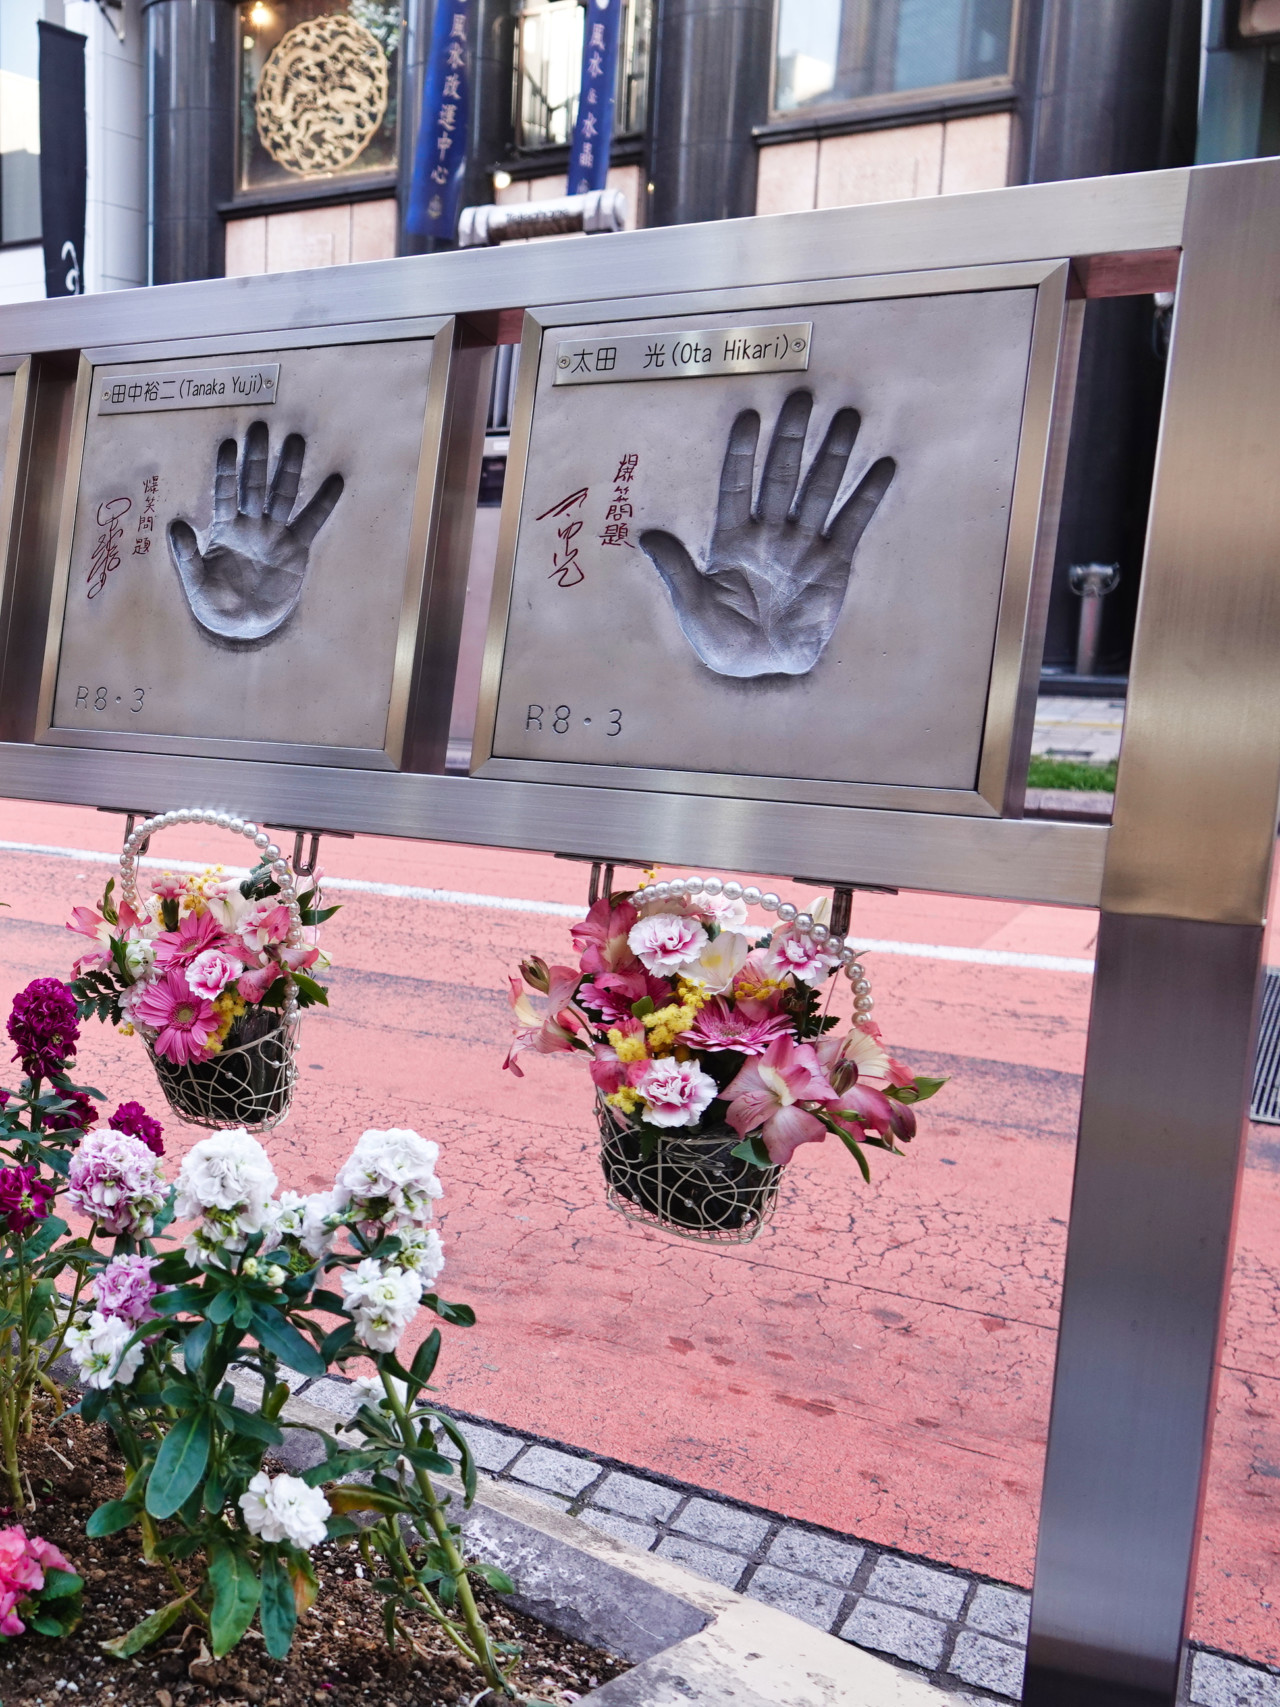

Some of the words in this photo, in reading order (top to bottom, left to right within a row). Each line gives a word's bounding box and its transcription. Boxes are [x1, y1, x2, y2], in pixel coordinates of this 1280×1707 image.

[570, 346, 618, 374] 太田
[722, 333, 789, 362] Hikari)
[231, 373, 263, 396] Yuji)
